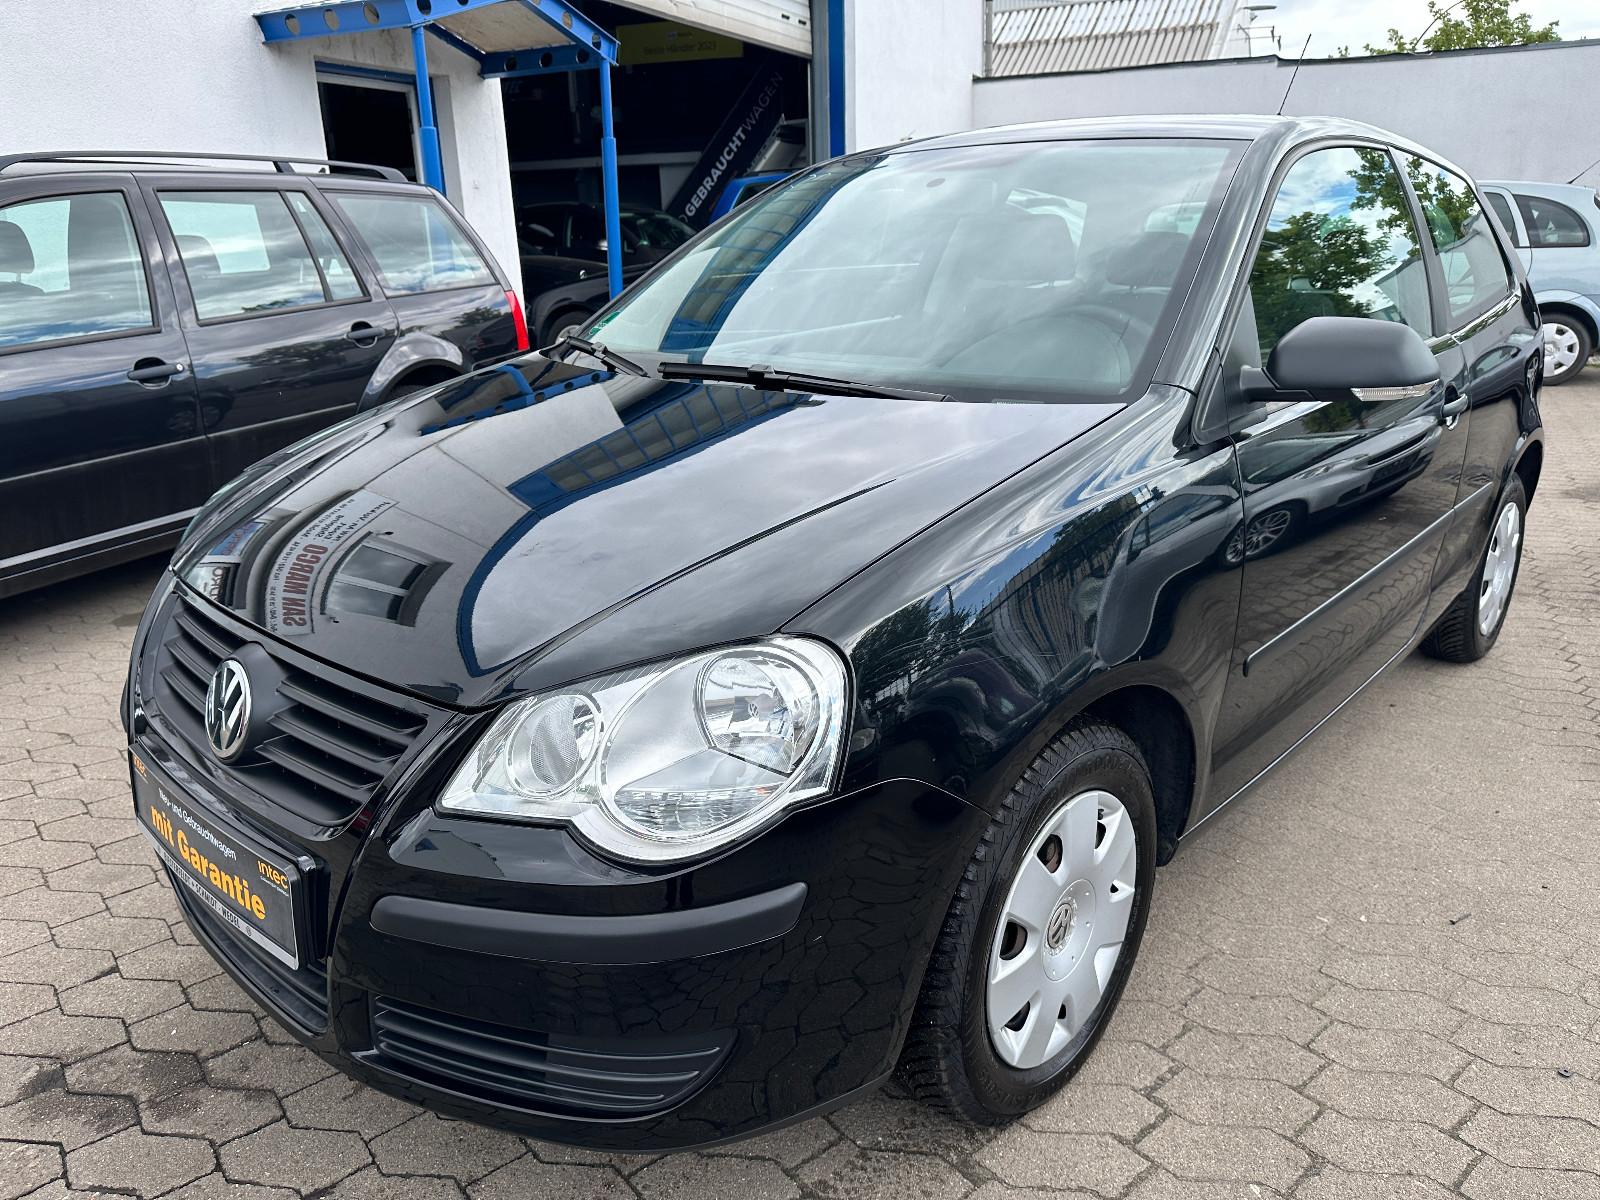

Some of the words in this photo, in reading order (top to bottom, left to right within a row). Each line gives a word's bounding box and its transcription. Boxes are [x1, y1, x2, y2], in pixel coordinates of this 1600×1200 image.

[685, 72, 783, 216] GEBRAUCHTWAGEN
[151, 805, 175, 848] mit
[177, 829, 266, 920] Garantie
[257, 860, 289, 890] intec
